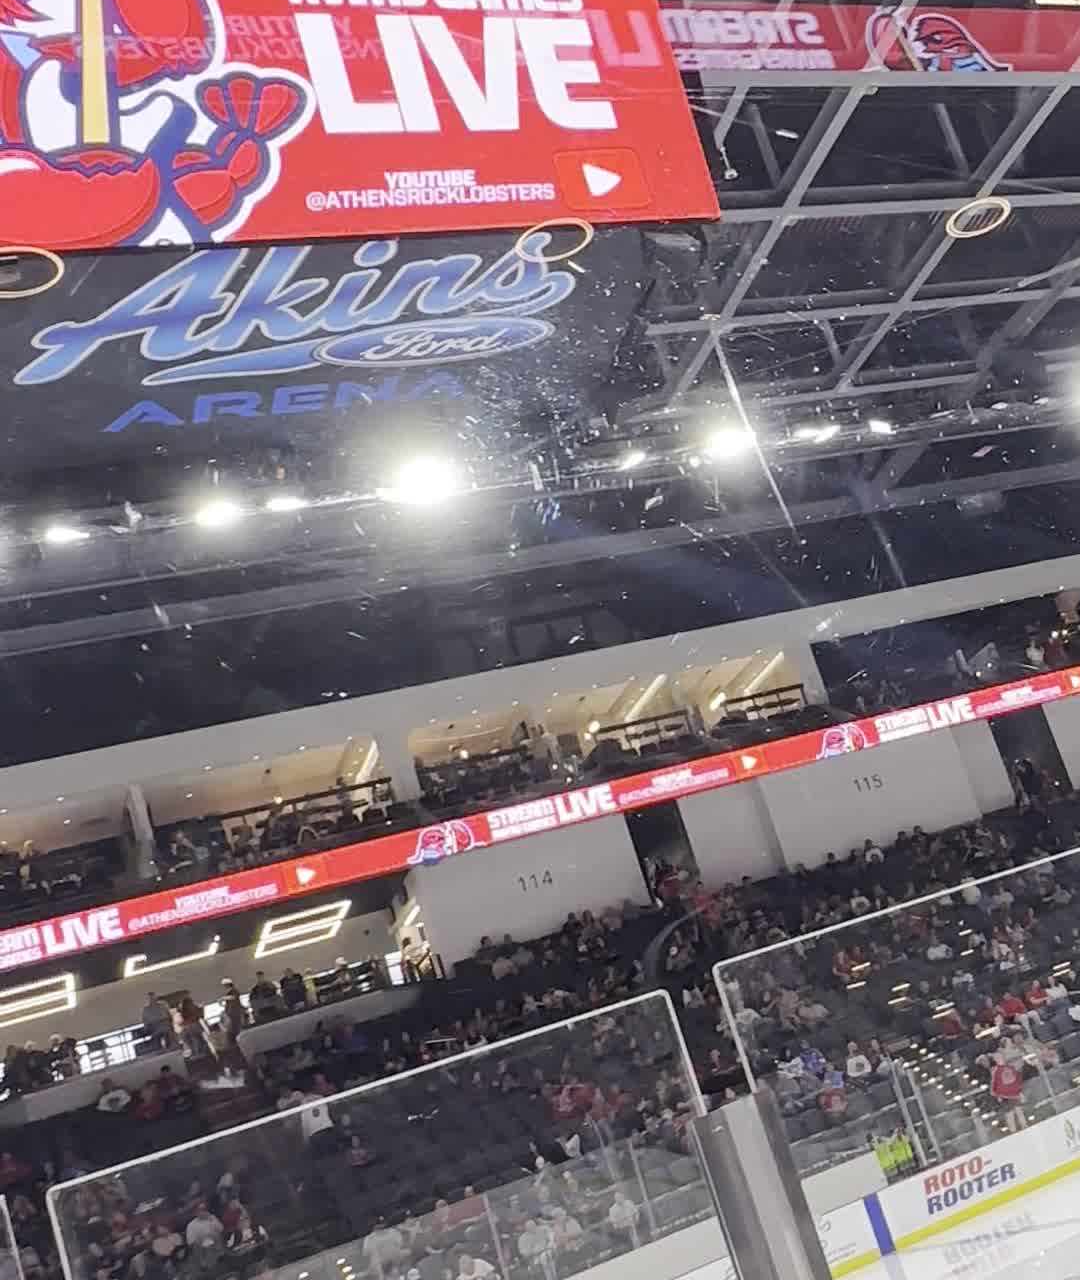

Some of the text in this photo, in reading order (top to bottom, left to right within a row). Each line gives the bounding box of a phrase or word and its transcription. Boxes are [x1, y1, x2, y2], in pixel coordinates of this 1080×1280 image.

[295, 12, 618, 134] LIVE
[306, 184, 554, 211] @ATHENSROCKLOBSTERS
[384, 169, 476, 190] YOUTUBE
[14, 229, 577, 385] Akins
[358, 326, 514, 362] Ford
[102, 368, 470, 432] ARENA
[556, 782, 618, 824] LIVE
[853, 774, 884, 794] 115
[518, 870, 554, 892] 114
[41, 907, 125, 954] LIVE
[923, 1154, 993, 1195] ROTO-
[926, 1162, 1017, 1216] ROOTER
